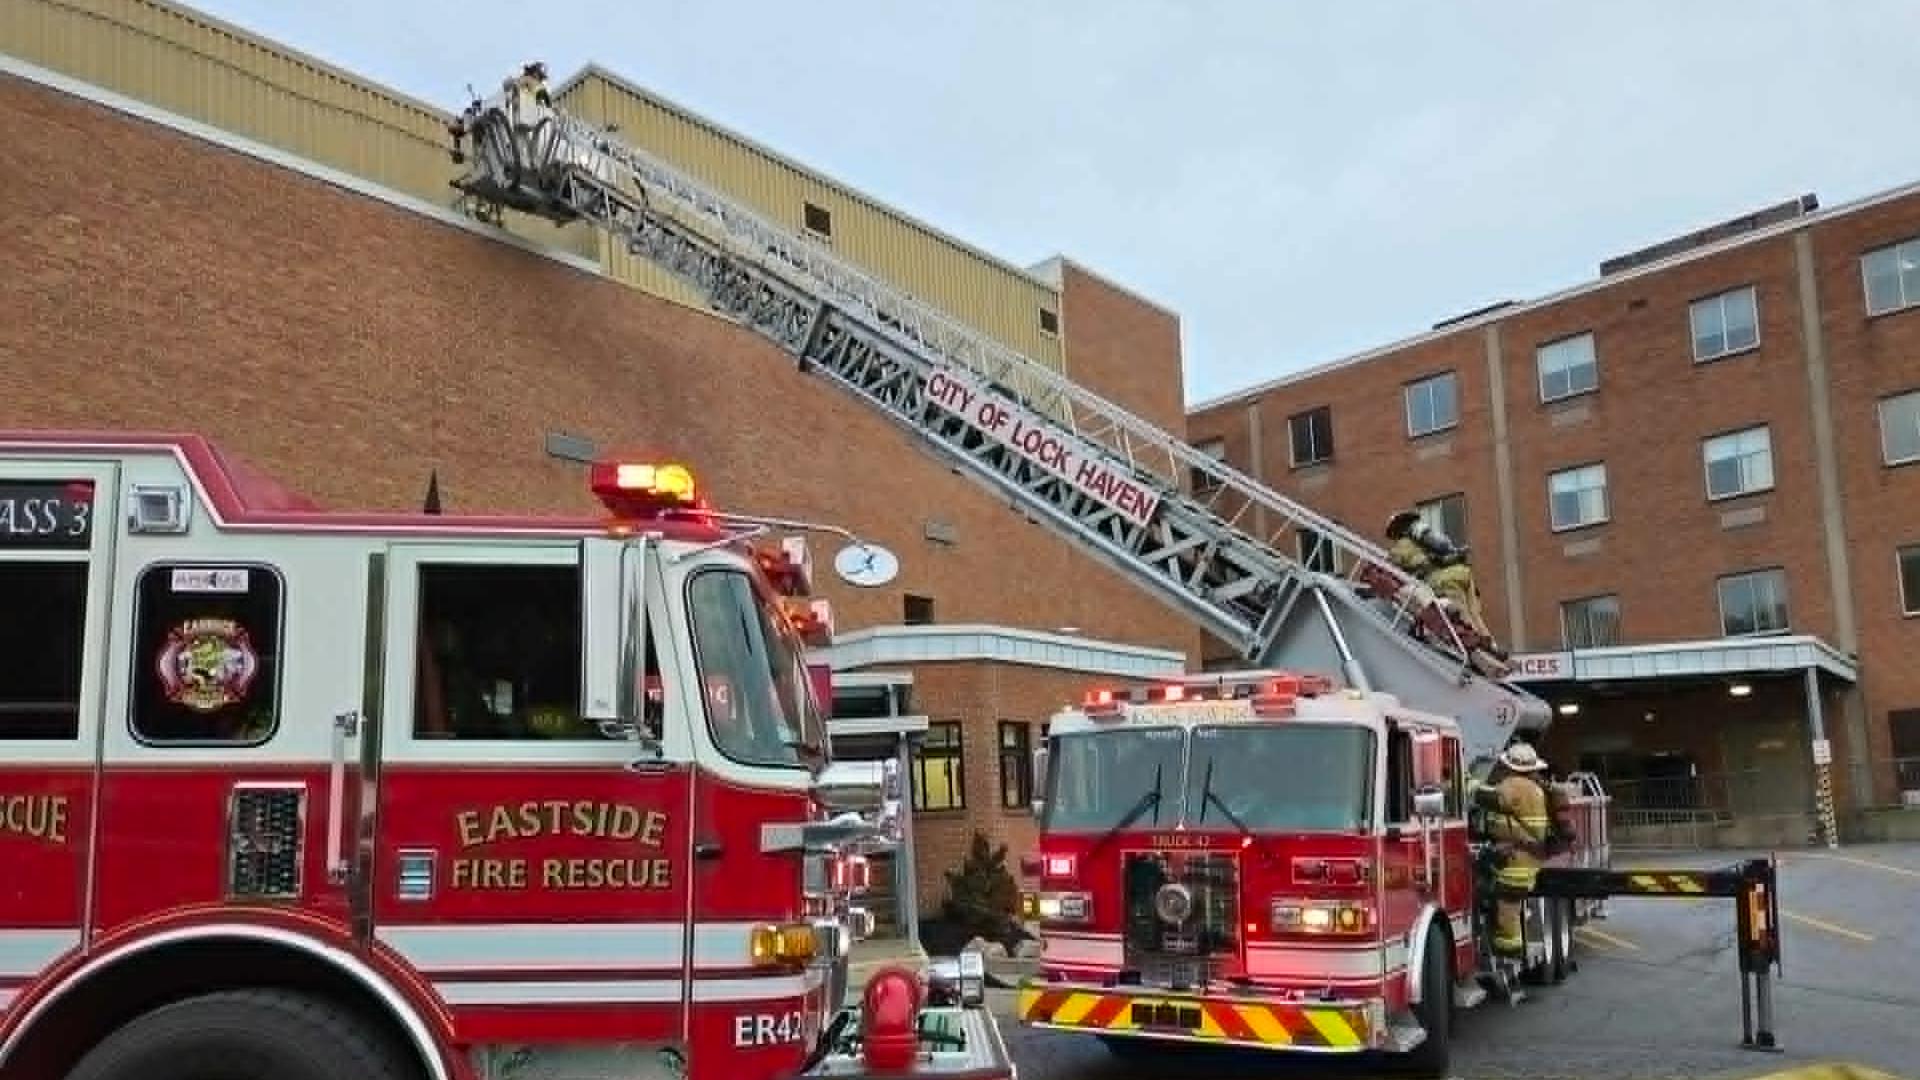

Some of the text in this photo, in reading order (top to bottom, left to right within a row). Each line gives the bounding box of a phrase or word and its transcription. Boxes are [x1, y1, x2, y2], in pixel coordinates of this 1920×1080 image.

[928, 373, 1155, 521] CITY OF LOCK HAVEN
[69, 500, 88, 535] 3
[456, 800, 667, 847] EASTSIDE
[452, 859, 670, 887] FIRE RESCUE
[735, 1012, 801, 1046] ER42
